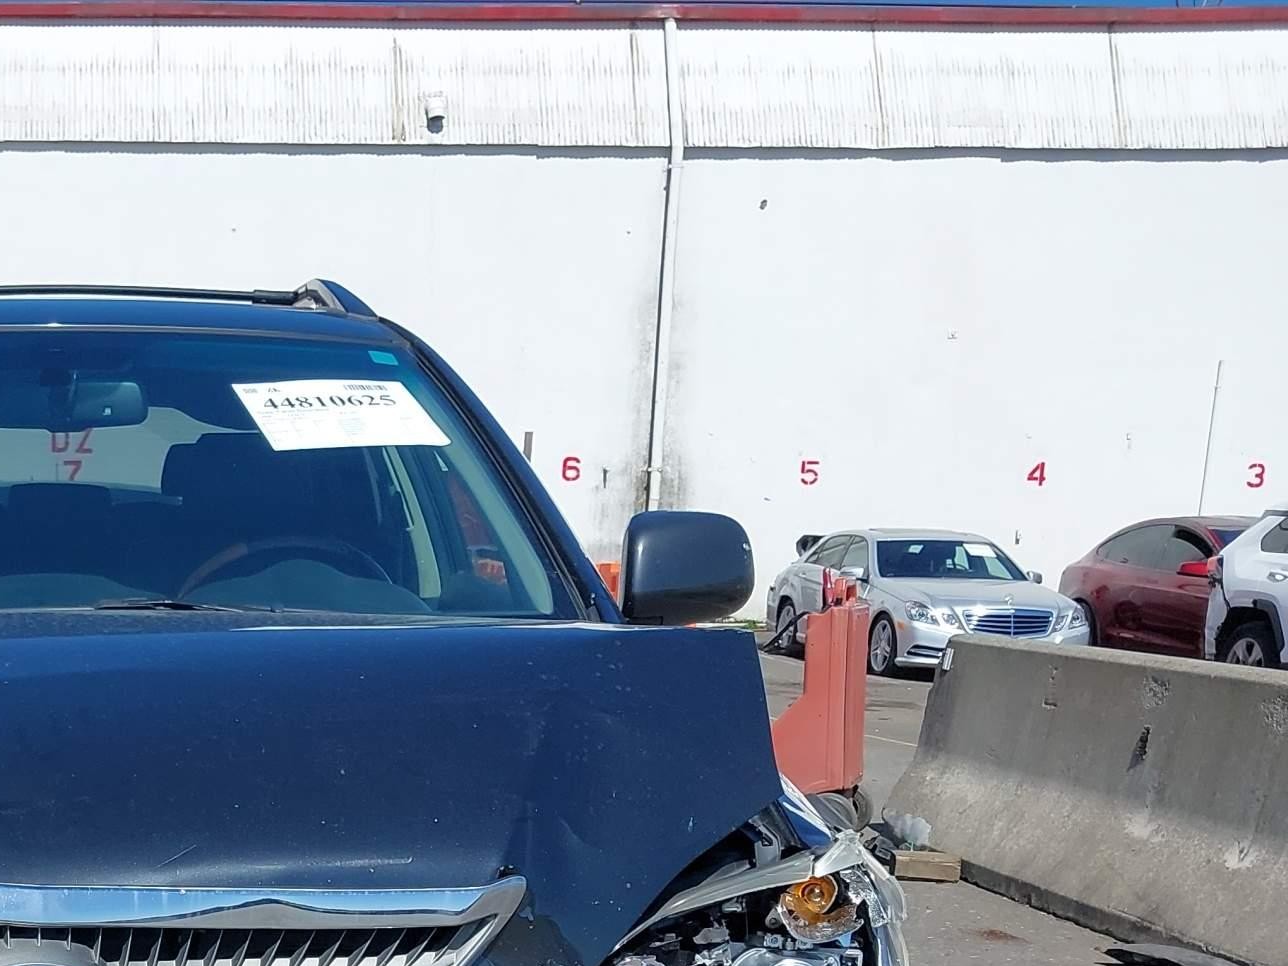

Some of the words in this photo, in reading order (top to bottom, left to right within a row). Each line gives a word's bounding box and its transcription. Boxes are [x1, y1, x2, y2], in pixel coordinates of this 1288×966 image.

[264, 394, 397, 410] 44810625
[63, 460, 83, 481] 7
[561, 456, 580, 481] 6
[800, 460, 819, 485] 5
[1027, 462, 1046, 486] 4
[1247, 463, 1265, 488] 3
